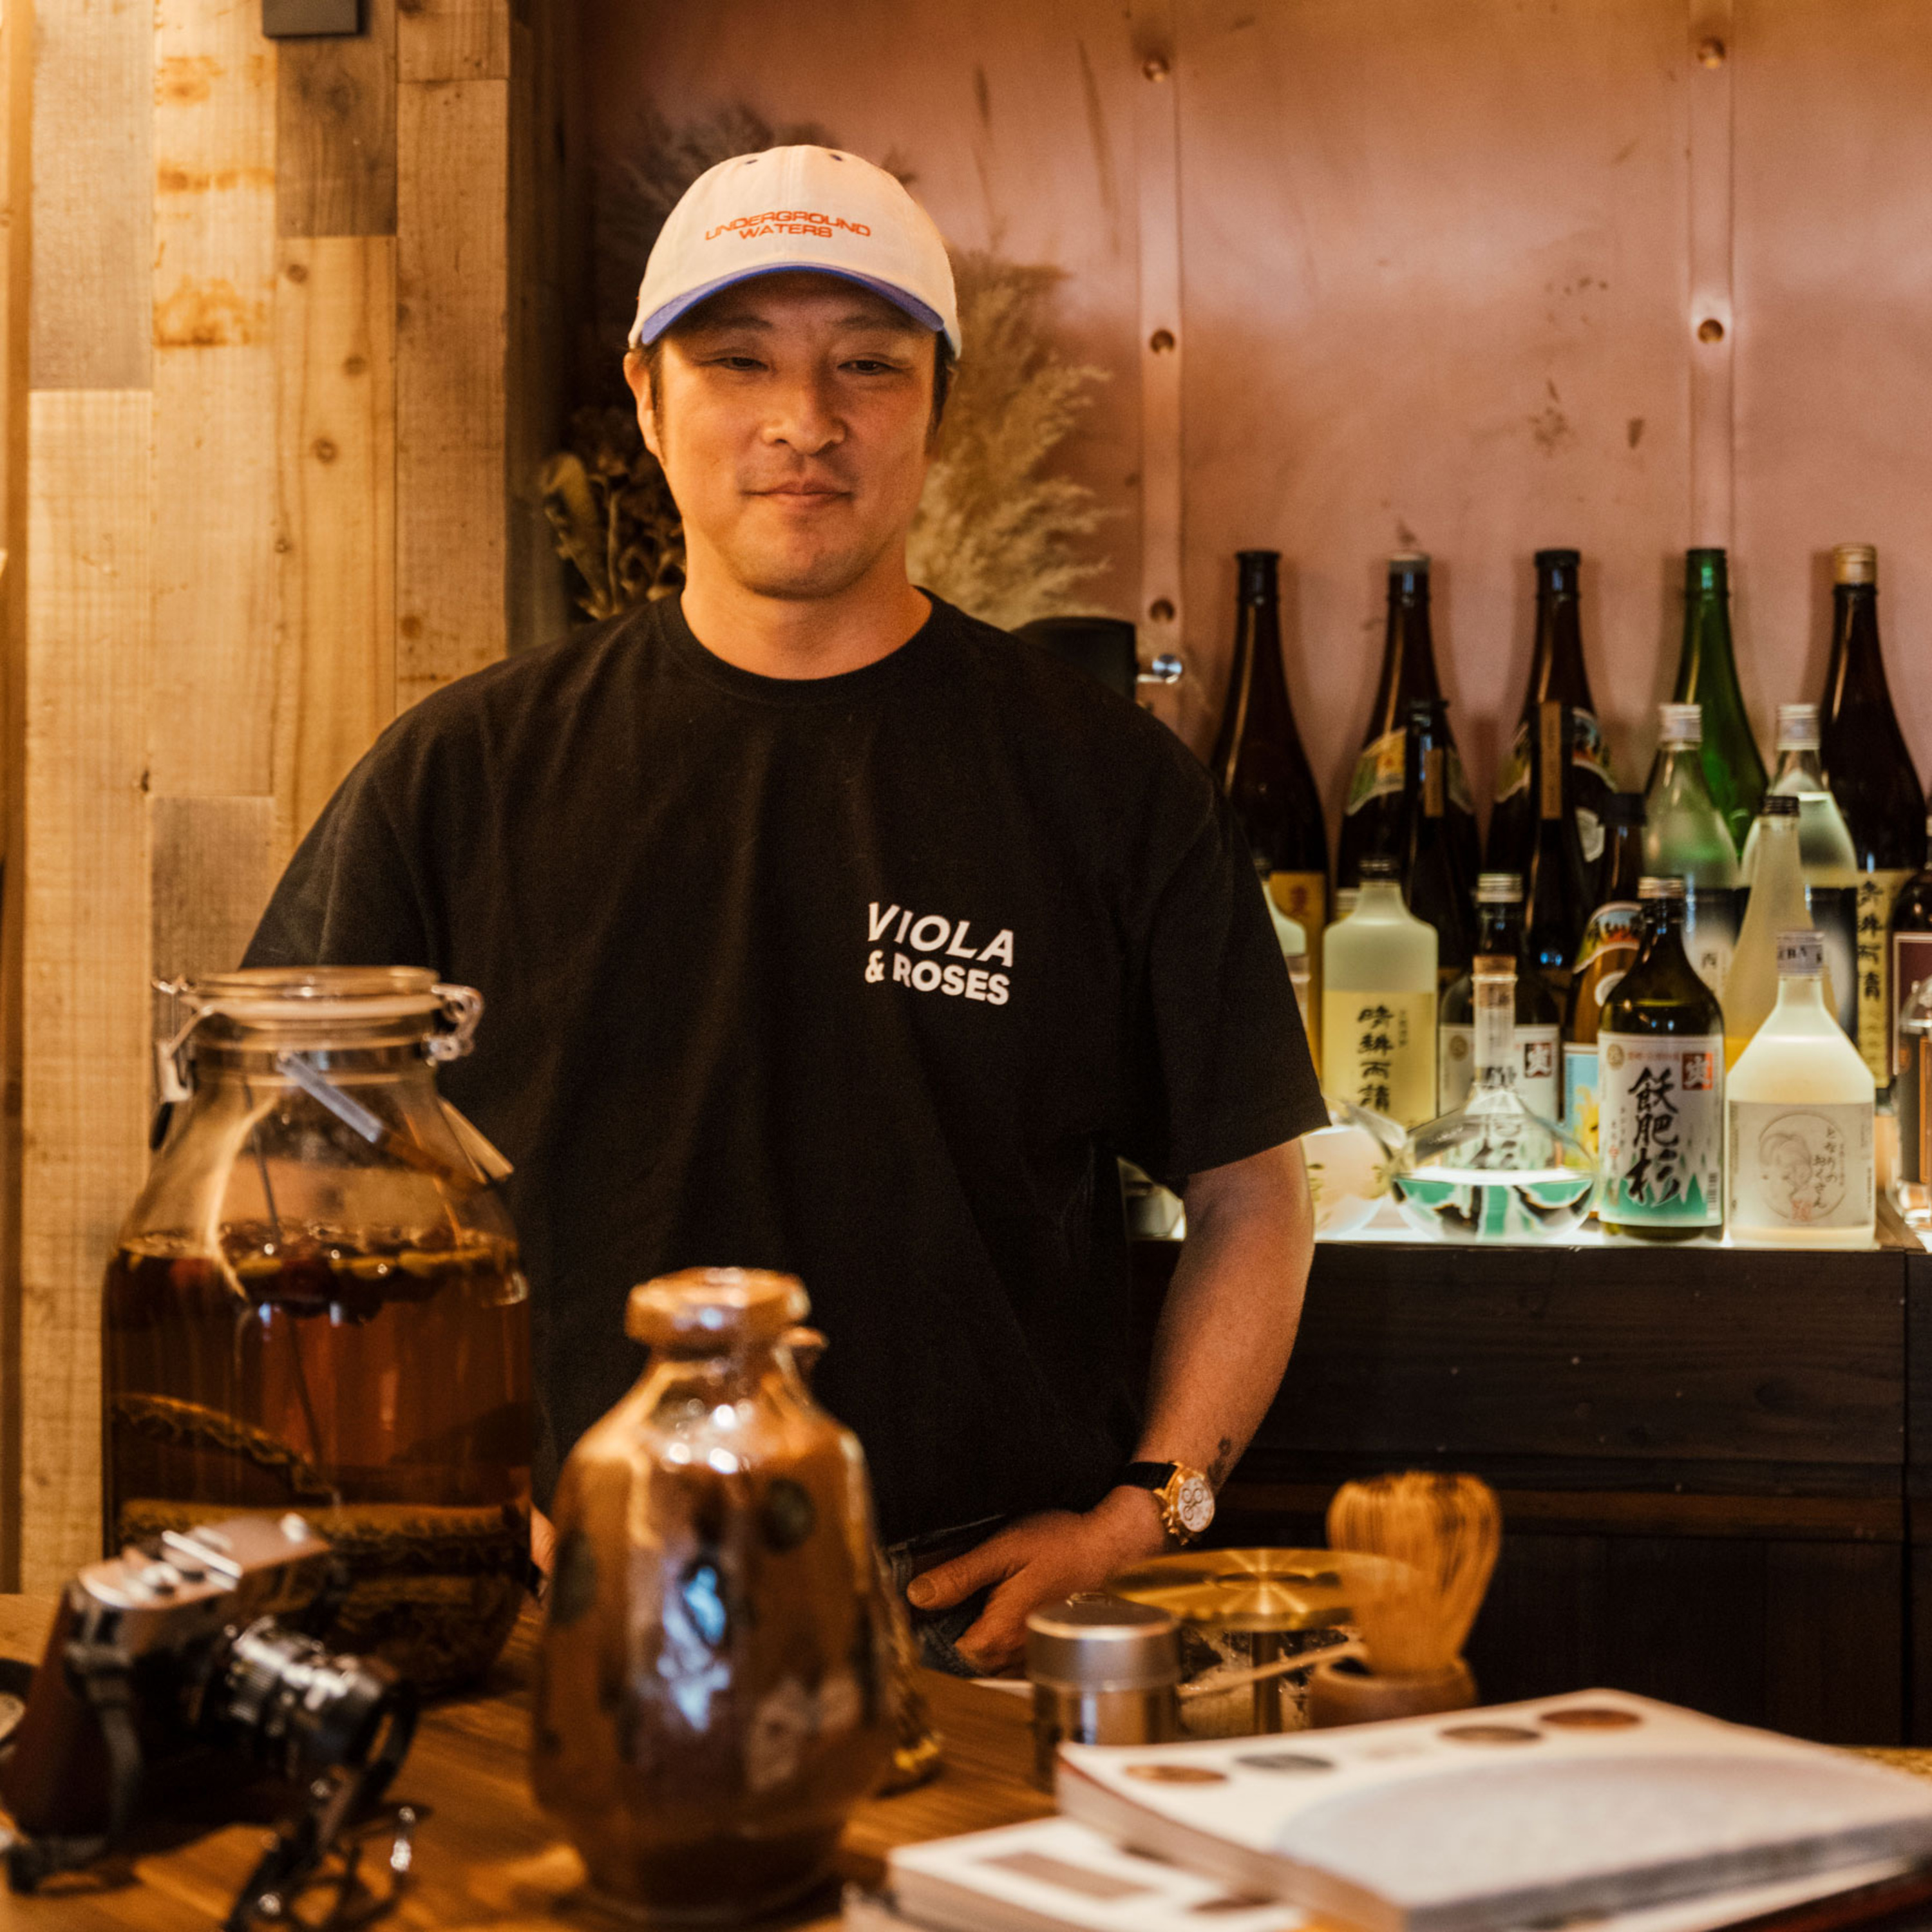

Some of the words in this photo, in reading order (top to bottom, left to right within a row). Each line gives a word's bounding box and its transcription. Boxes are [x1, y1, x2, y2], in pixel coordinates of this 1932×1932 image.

[705, 211, 871, 240] UNDERGROUND
[739, 223, 833, 239] WATERS
[867, 902, 1014, 967] VIOLA
[865, 949, 885, 983] &
[893, 952, 1010, 1005] ROSES
